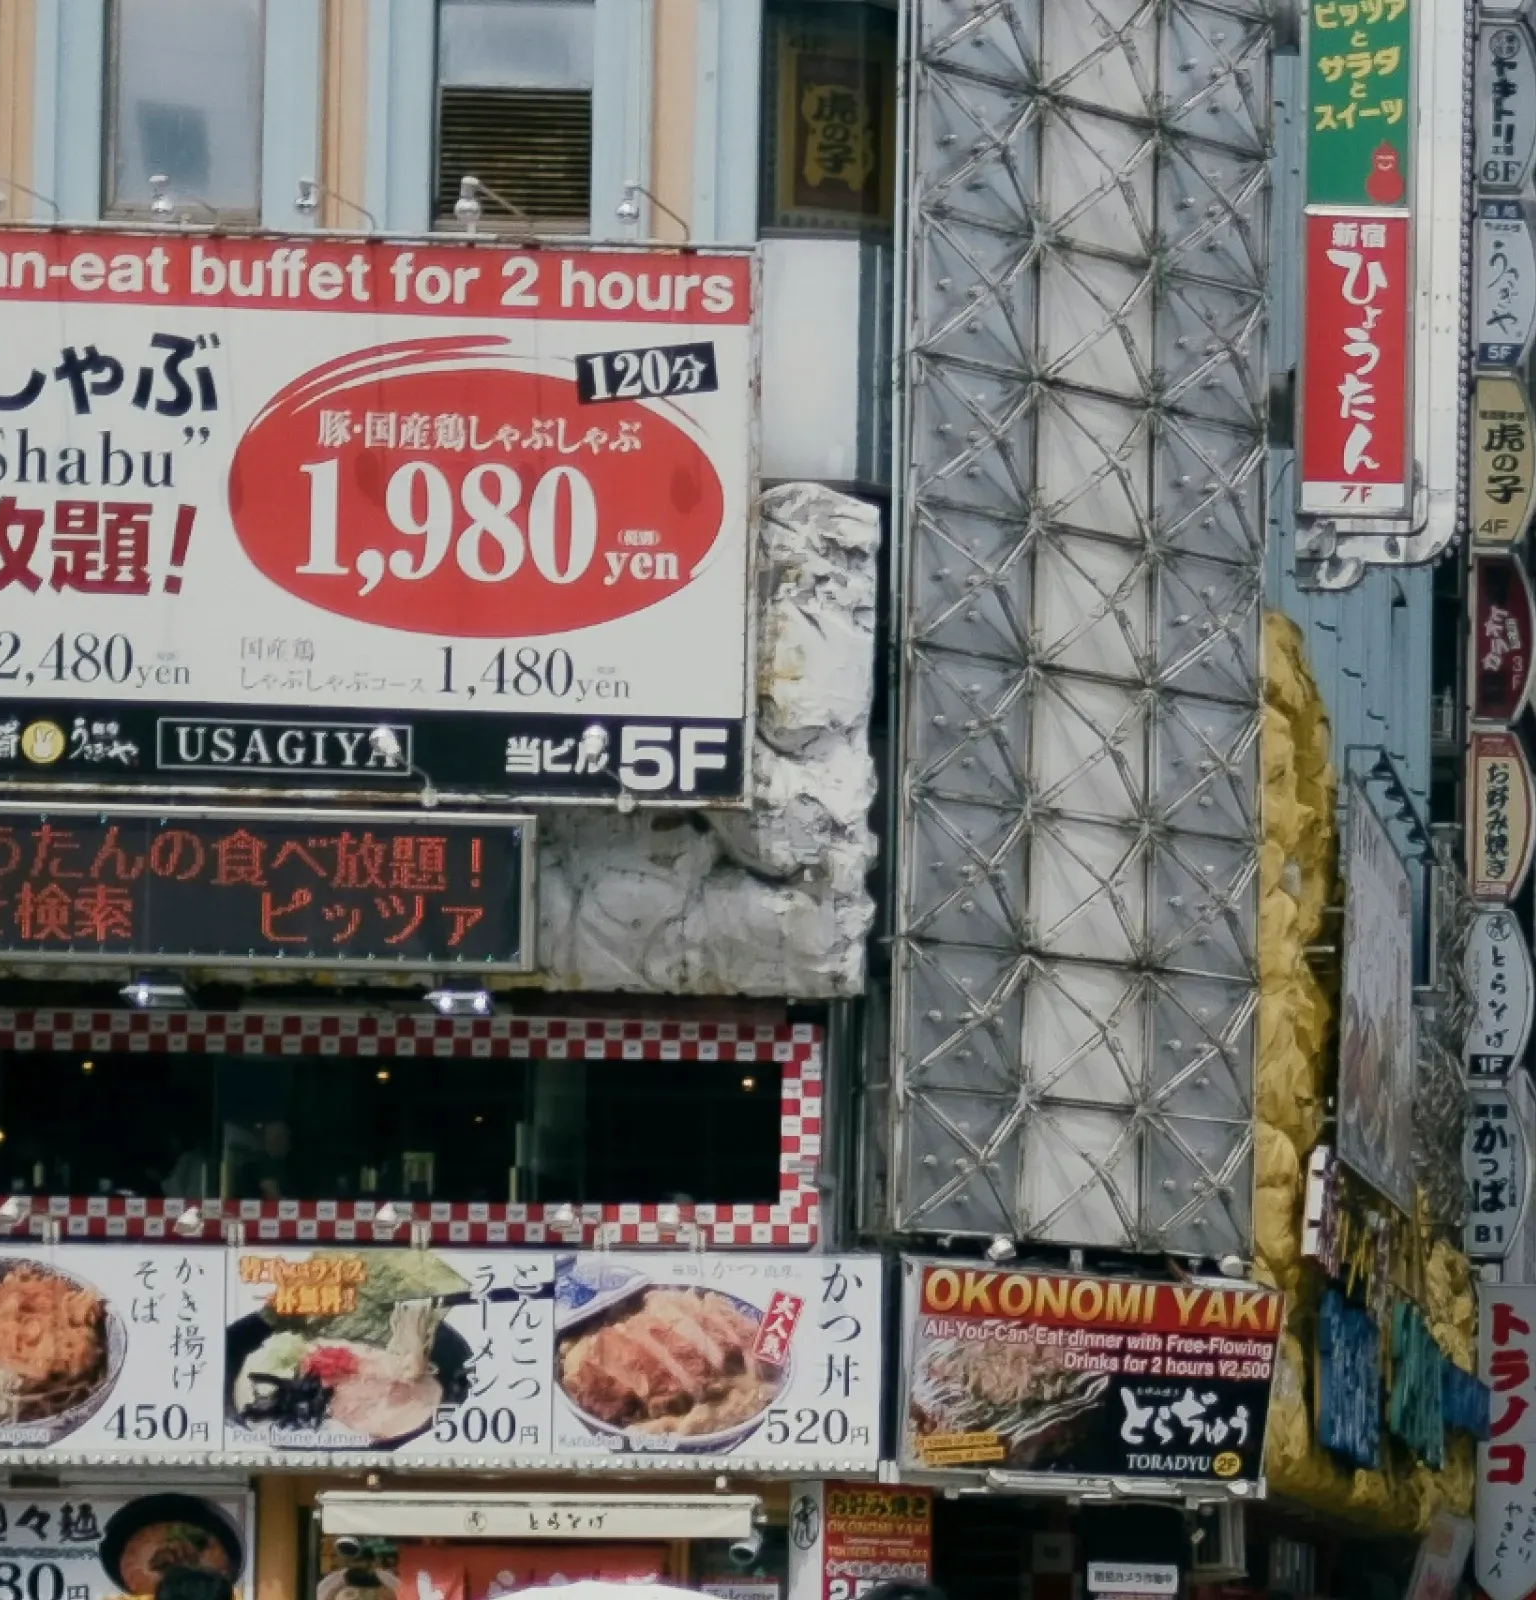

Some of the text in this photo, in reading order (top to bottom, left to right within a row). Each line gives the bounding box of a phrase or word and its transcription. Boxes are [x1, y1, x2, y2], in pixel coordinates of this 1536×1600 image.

[1318, 47, 1400, 82] サラダ
[1314, 101, 1403, 130] スイーツ
[1483, 160, 1521, 182] 6F
[1332, 224, 1386, 248] 新宿
[191, 243, 370, 301] buffet
[391, 252, 480, 305] for
[500, 255, 540, 307] 2
[561, 260, 735, 314] hours
[588, 348, 707, 400] 120分
[1326, 248, 1388, 474] ひょうたん
[1483, 423, 1526, 504] 虎の子
[296, 458, 679, 596] 1,980 yen
[1478, 520, 1509, 535] 4F
[135, 661, 191, 689] yen
[436, 644, 631, 703] 1,480 yen
[618, 725, 728, 792] 5F
[1476, 1057, 1505, 1075] 1F
[1472, 1119, 1509, 1214] かっぱ
[1474, 1224, 1504, 1245] B1
[130, 1259, 160, 1324] そば
[924, 1268, 1278, 1331] OKONOMI YAKI
[169, 1256, 207, 1392] かき揚げ
[467, 1264, 500, 1398] ラーメン
[509, 1263, 543, 1400] とんこつ
[819, 1262, 864, 1398] かつ丼
[922, 1320, 1273, 1360] All-You-Can-Eat dinner with Free-Flowing
[1064, 1351, 1120, 1372] Drinks
[1123, 1354, 1148, 1373] for
[1151, 1356, 1162, 1374] 2
[1166, 1355, 1214, 1377] hours
[1487, 1302, 1531, 1485] トラノコ
[104, 1403, 211, 1443] 450円
[433, 1406, 539, 1446] 500円
[767, 1408, 870, 1447] 520円
[1126, 1454, 1240, 1472] TORADYU 2F
